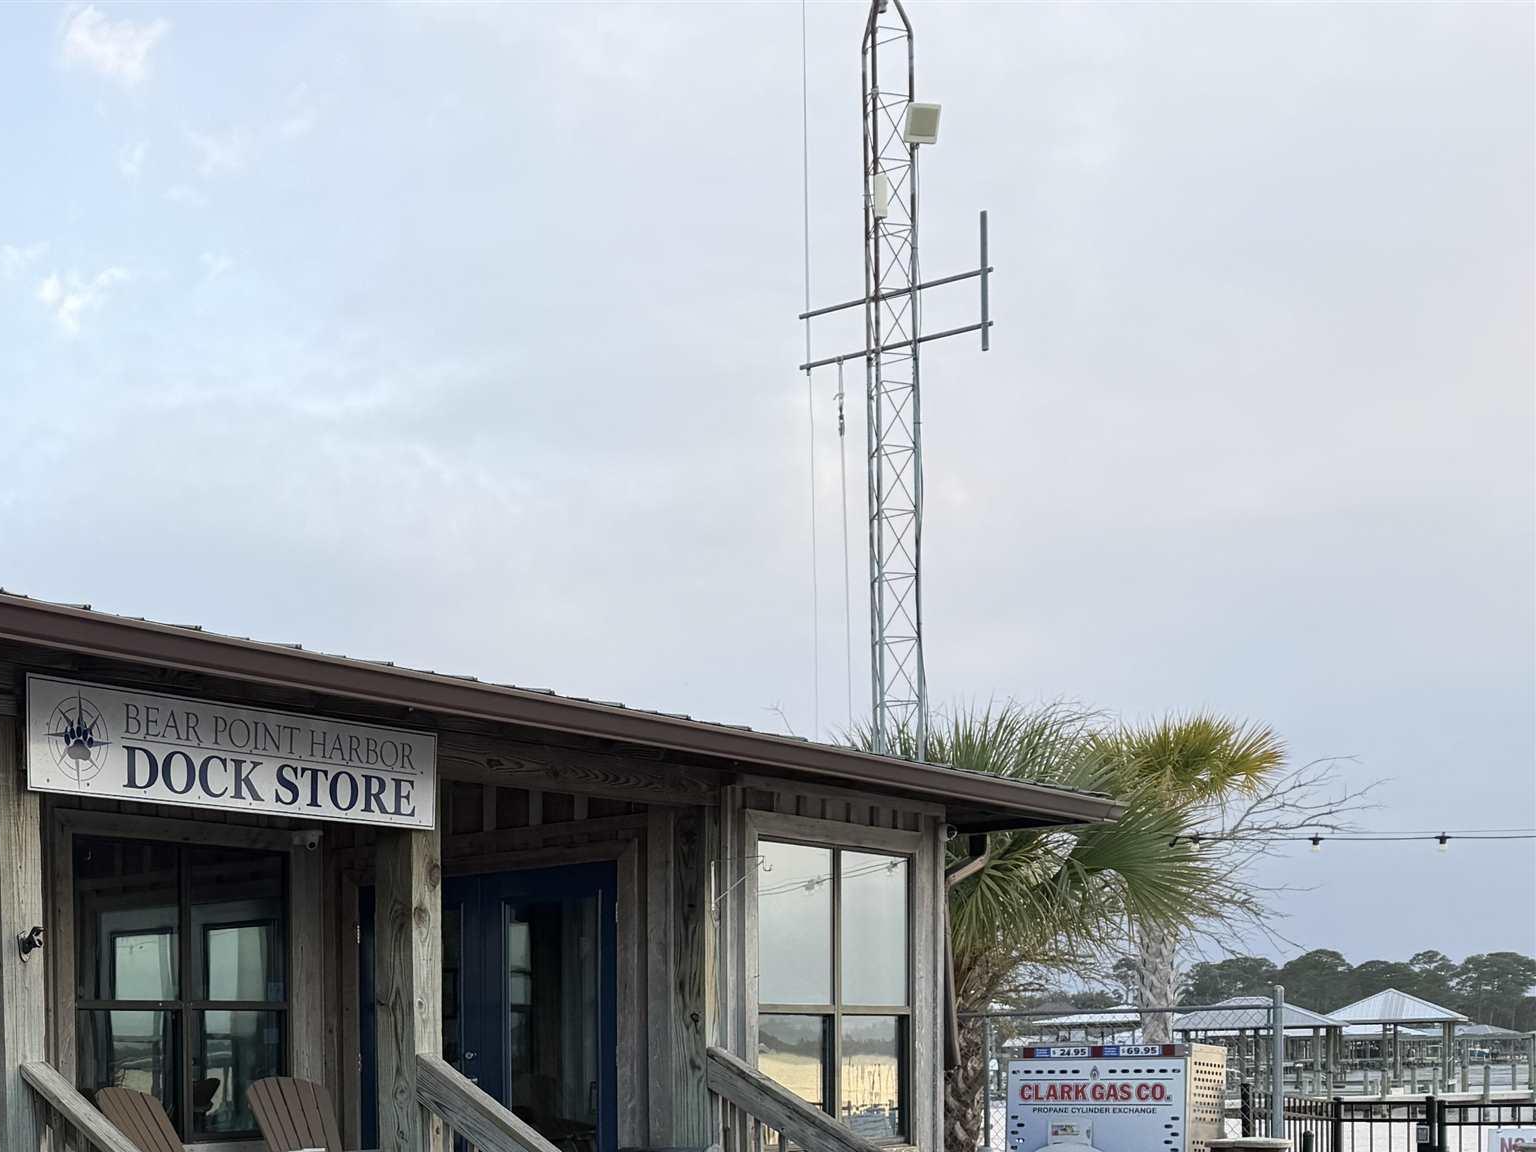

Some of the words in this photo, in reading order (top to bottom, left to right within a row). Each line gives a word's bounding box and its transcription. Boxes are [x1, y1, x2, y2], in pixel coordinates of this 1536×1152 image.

[124, 703, 202, 743] BEAR
[213, 715, 301, 756] POINT
[309, 730, 415, 769] HARBOR
[122, 745, 265, 802] DOCK
[274, 764, 416, 818] STORE
[1020, 1083, 1088, 1101] CLARK
[1091, 1083, 1132, 1101] GAS
